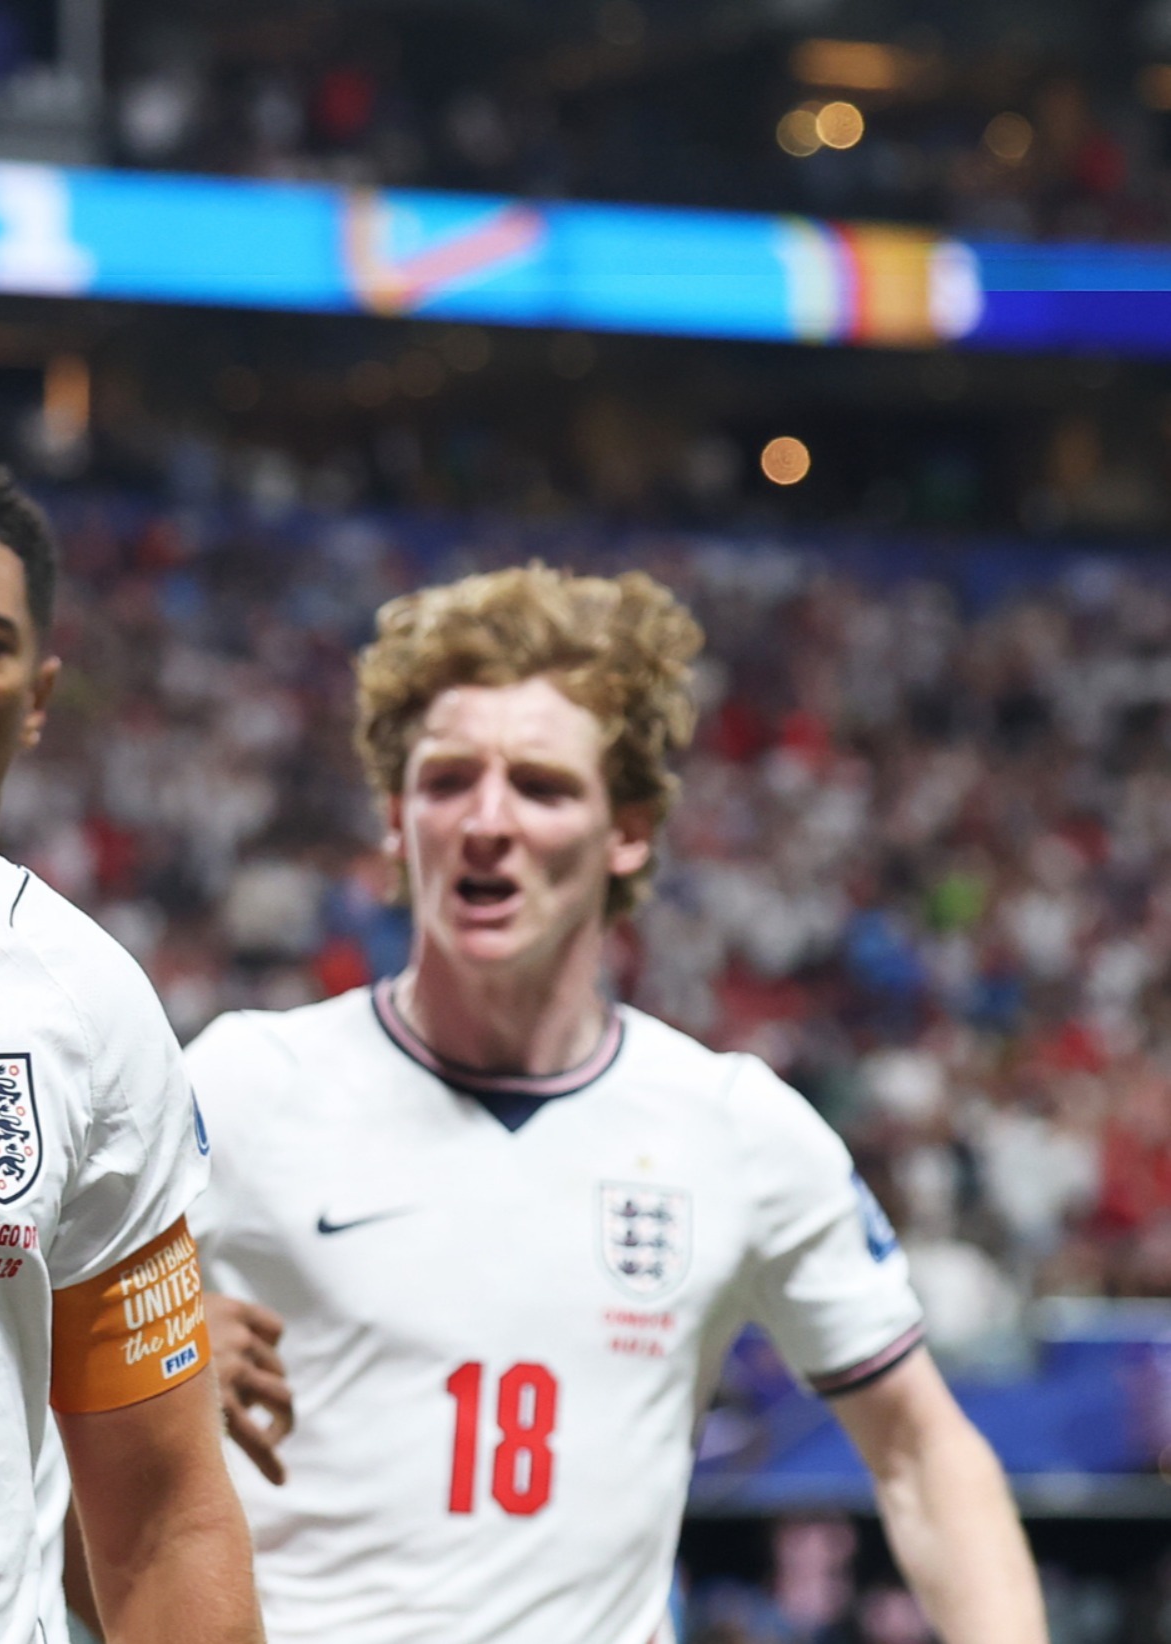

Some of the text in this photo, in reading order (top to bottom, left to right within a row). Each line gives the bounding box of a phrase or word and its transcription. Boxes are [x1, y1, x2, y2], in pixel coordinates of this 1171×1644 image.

[120, 1232, 194, 1295] FOOTBALL
[123, 1257, 201, 1330] UNITES
[120, 1330, 164, 1365] the
[165, 1348, 196, 1374] FIFA
[446, 1361, 558, 1515] 18
